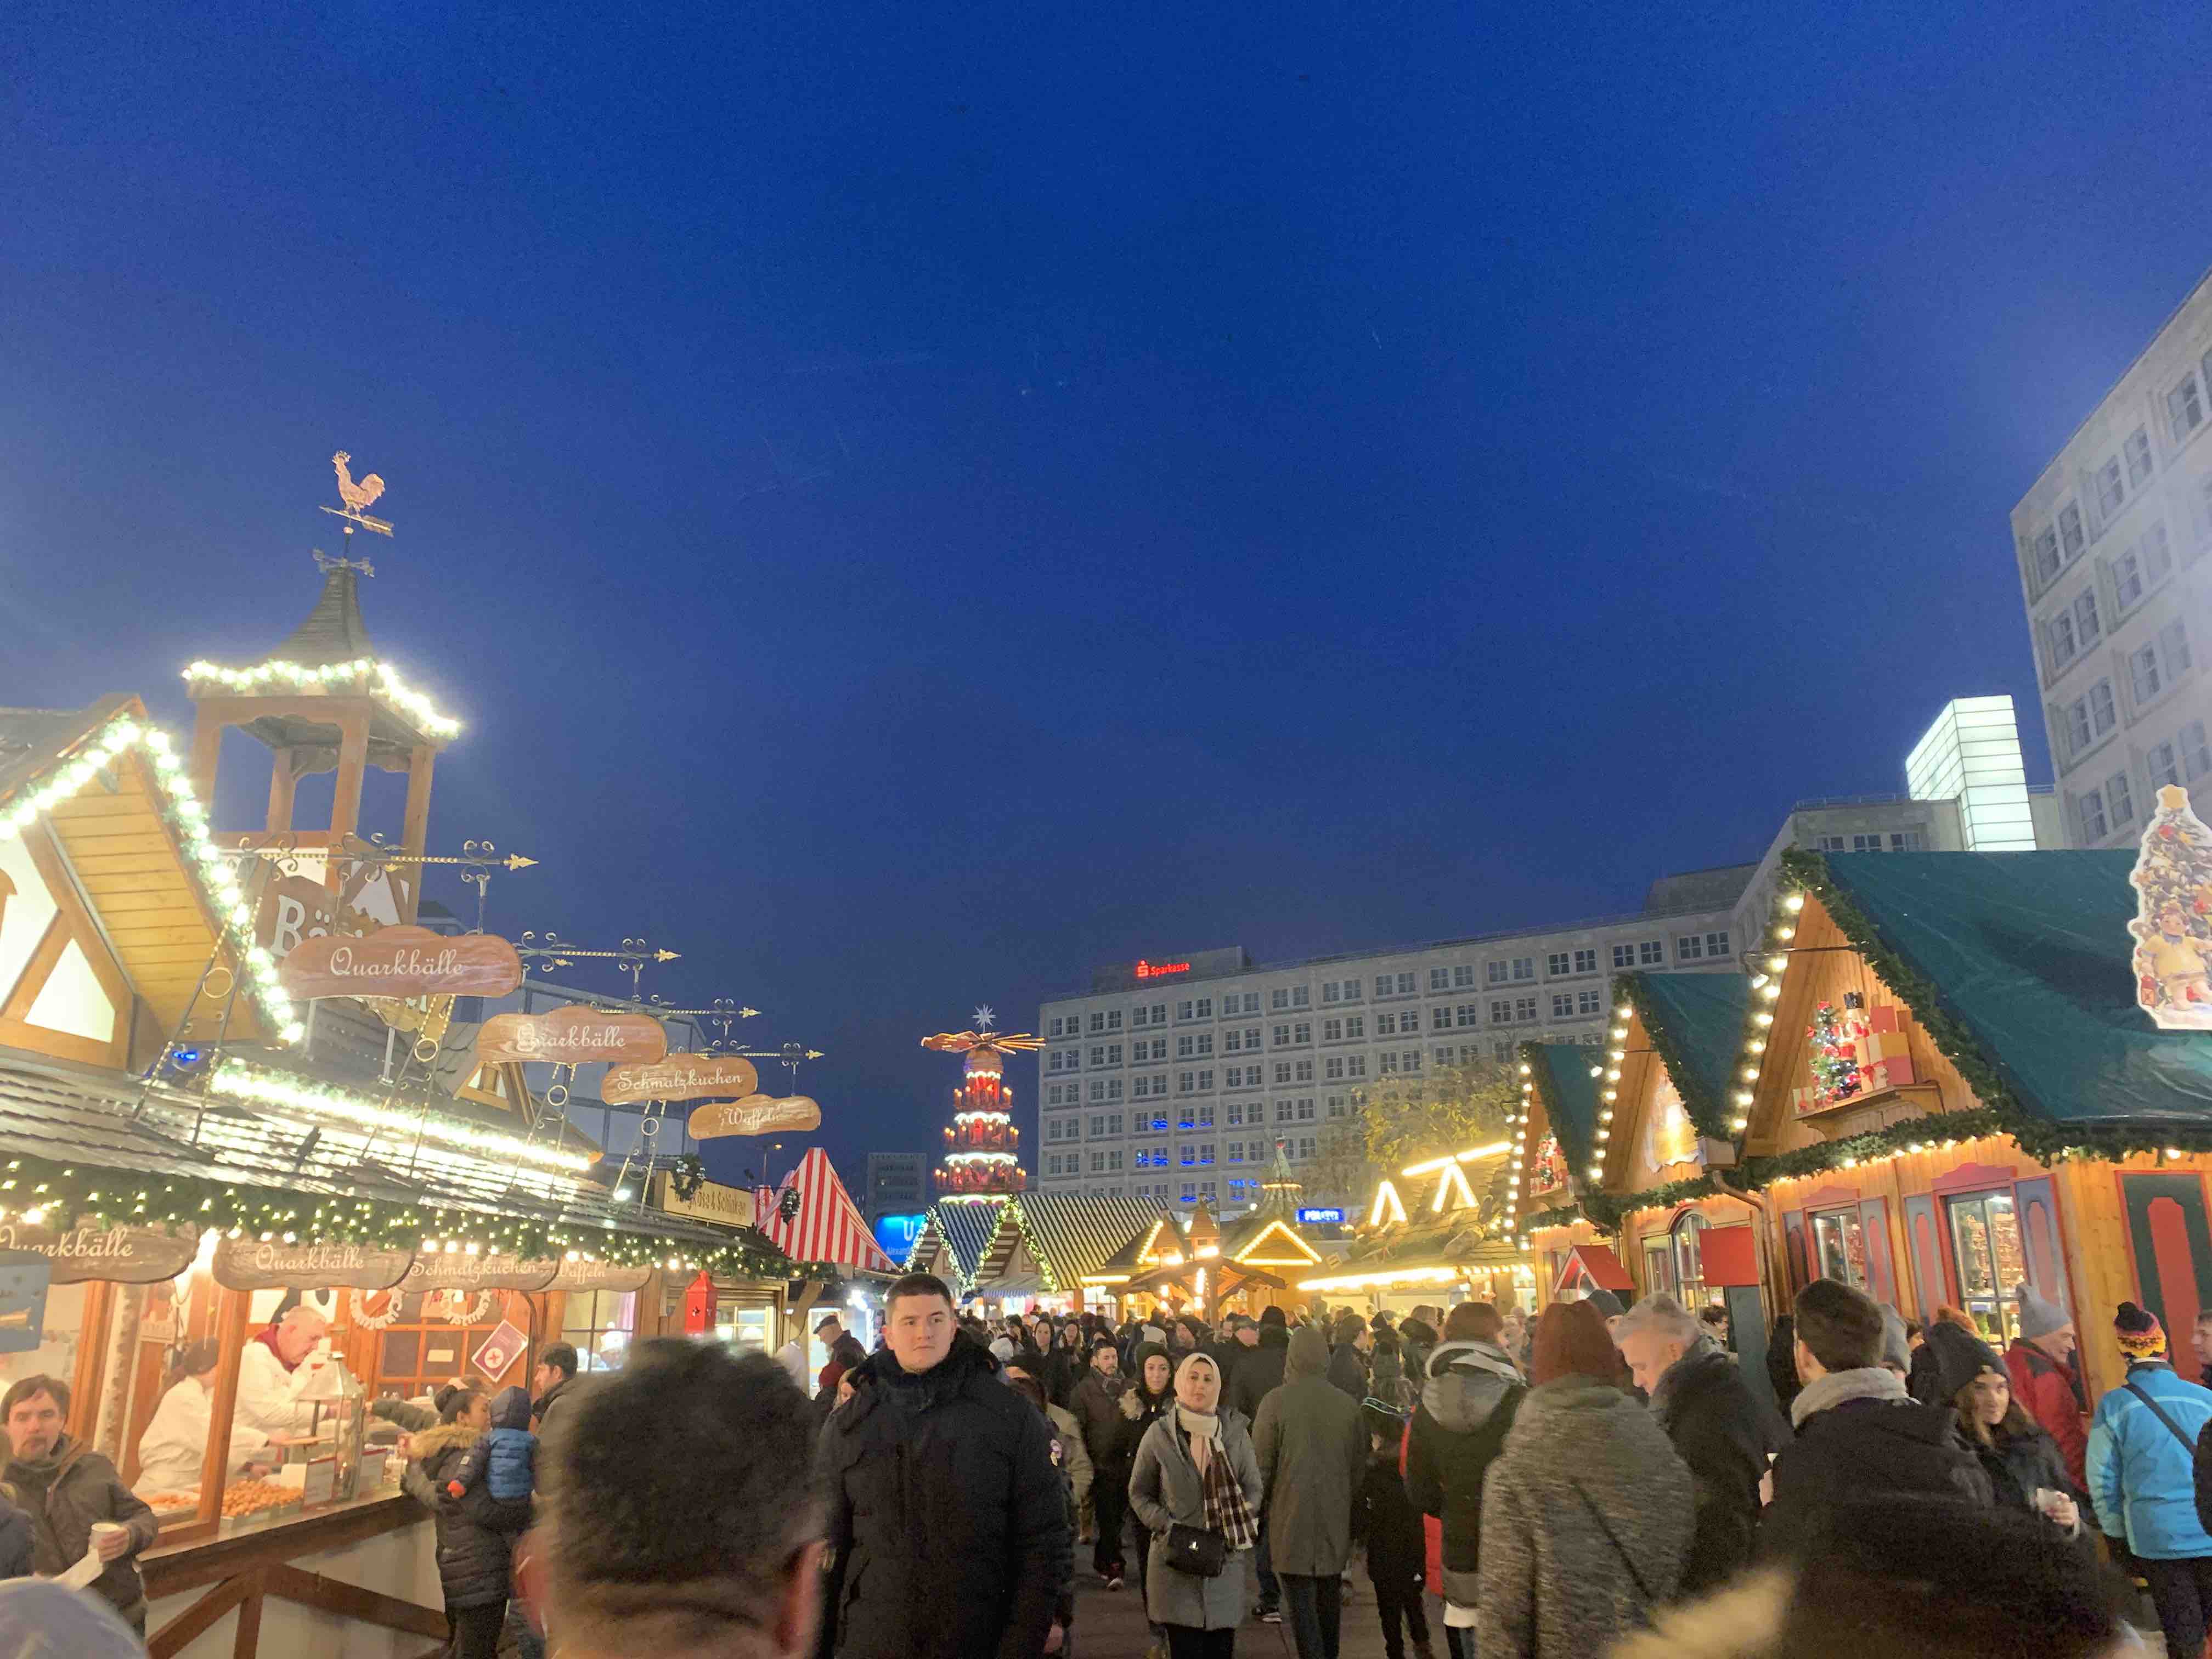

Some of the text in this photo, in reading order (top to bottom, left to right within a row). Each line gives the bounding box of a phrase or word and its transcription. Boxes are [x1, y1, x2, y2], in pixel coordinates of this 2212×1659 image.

[330, 946, 465, 976] Quarkbälle
[1150, 963, 1190, 978] Sparkasse
[516, 1023, 627, 1052] Quarkbälle
[617, 1066, 742, 1095] Schmalzkuchen
[903, 1220, 915, 1242] U
[255, 1244, 365, 1270] Quarkbälle
[410, 1254, 537, 1283] Schmalzkuchen
